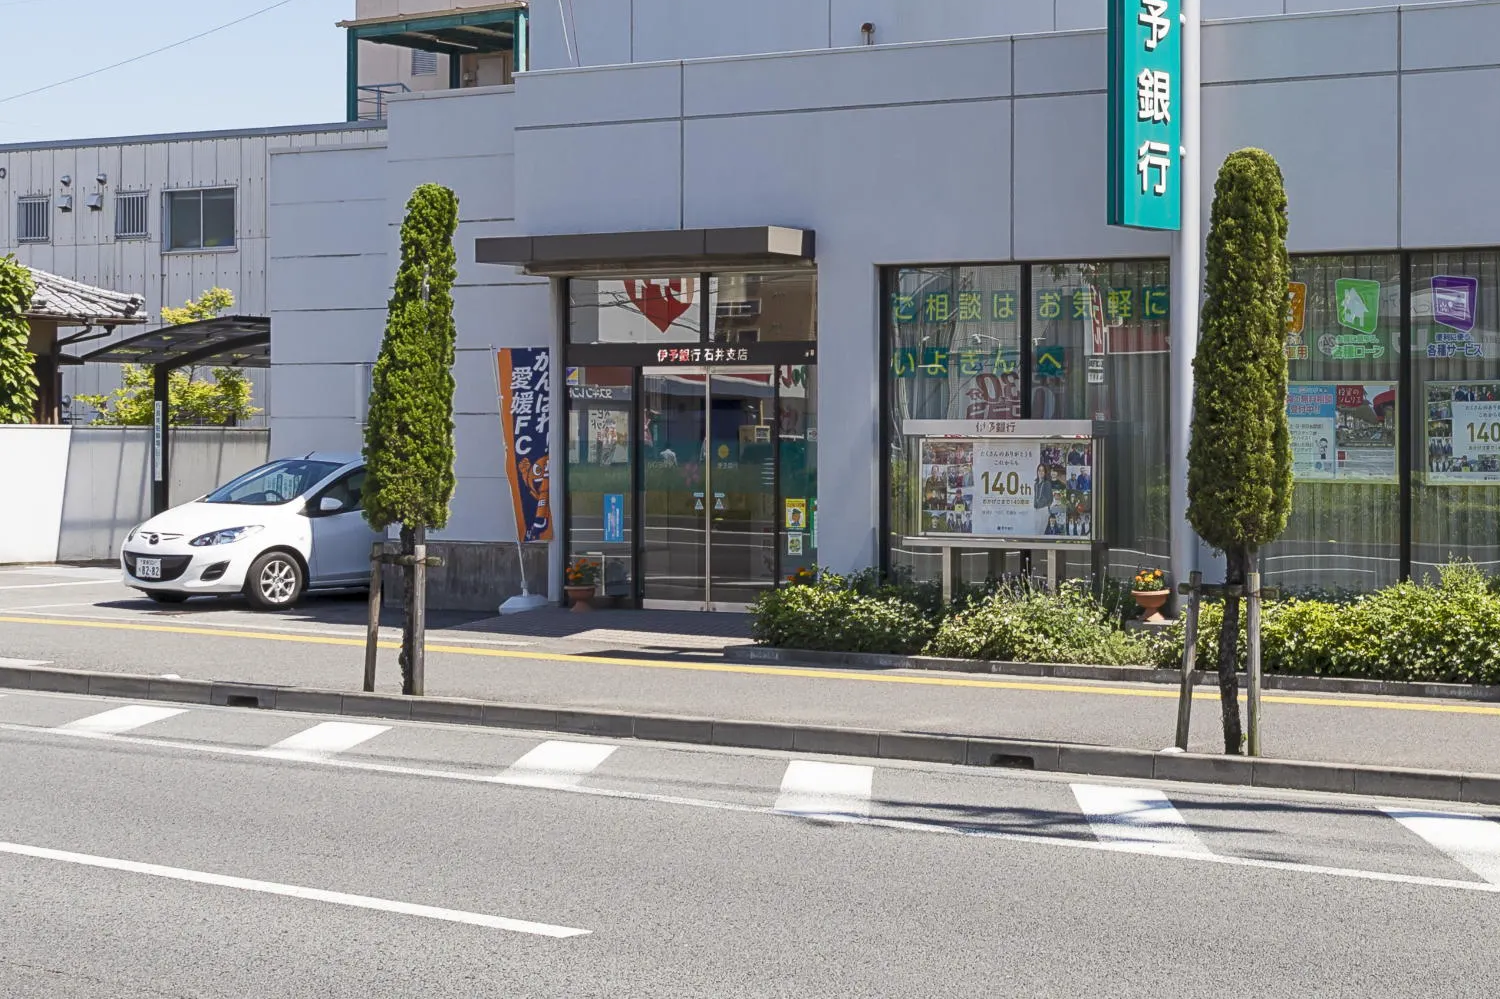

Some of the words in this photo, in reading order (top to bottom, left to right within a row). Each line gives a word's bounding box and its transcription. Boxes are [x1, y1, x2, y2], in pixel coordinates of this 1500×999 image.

[657, 348, 700, 362] 伊予銀行
[703, 348, 748, 361] 石井支店
[1427, 343, 1484, 358] 各種サービス
[510, 366, 534, 456] 愛媛FC
[976, 422, 1016, 433] 伊予銀行
[981, 471, 1032, 496] 140th
